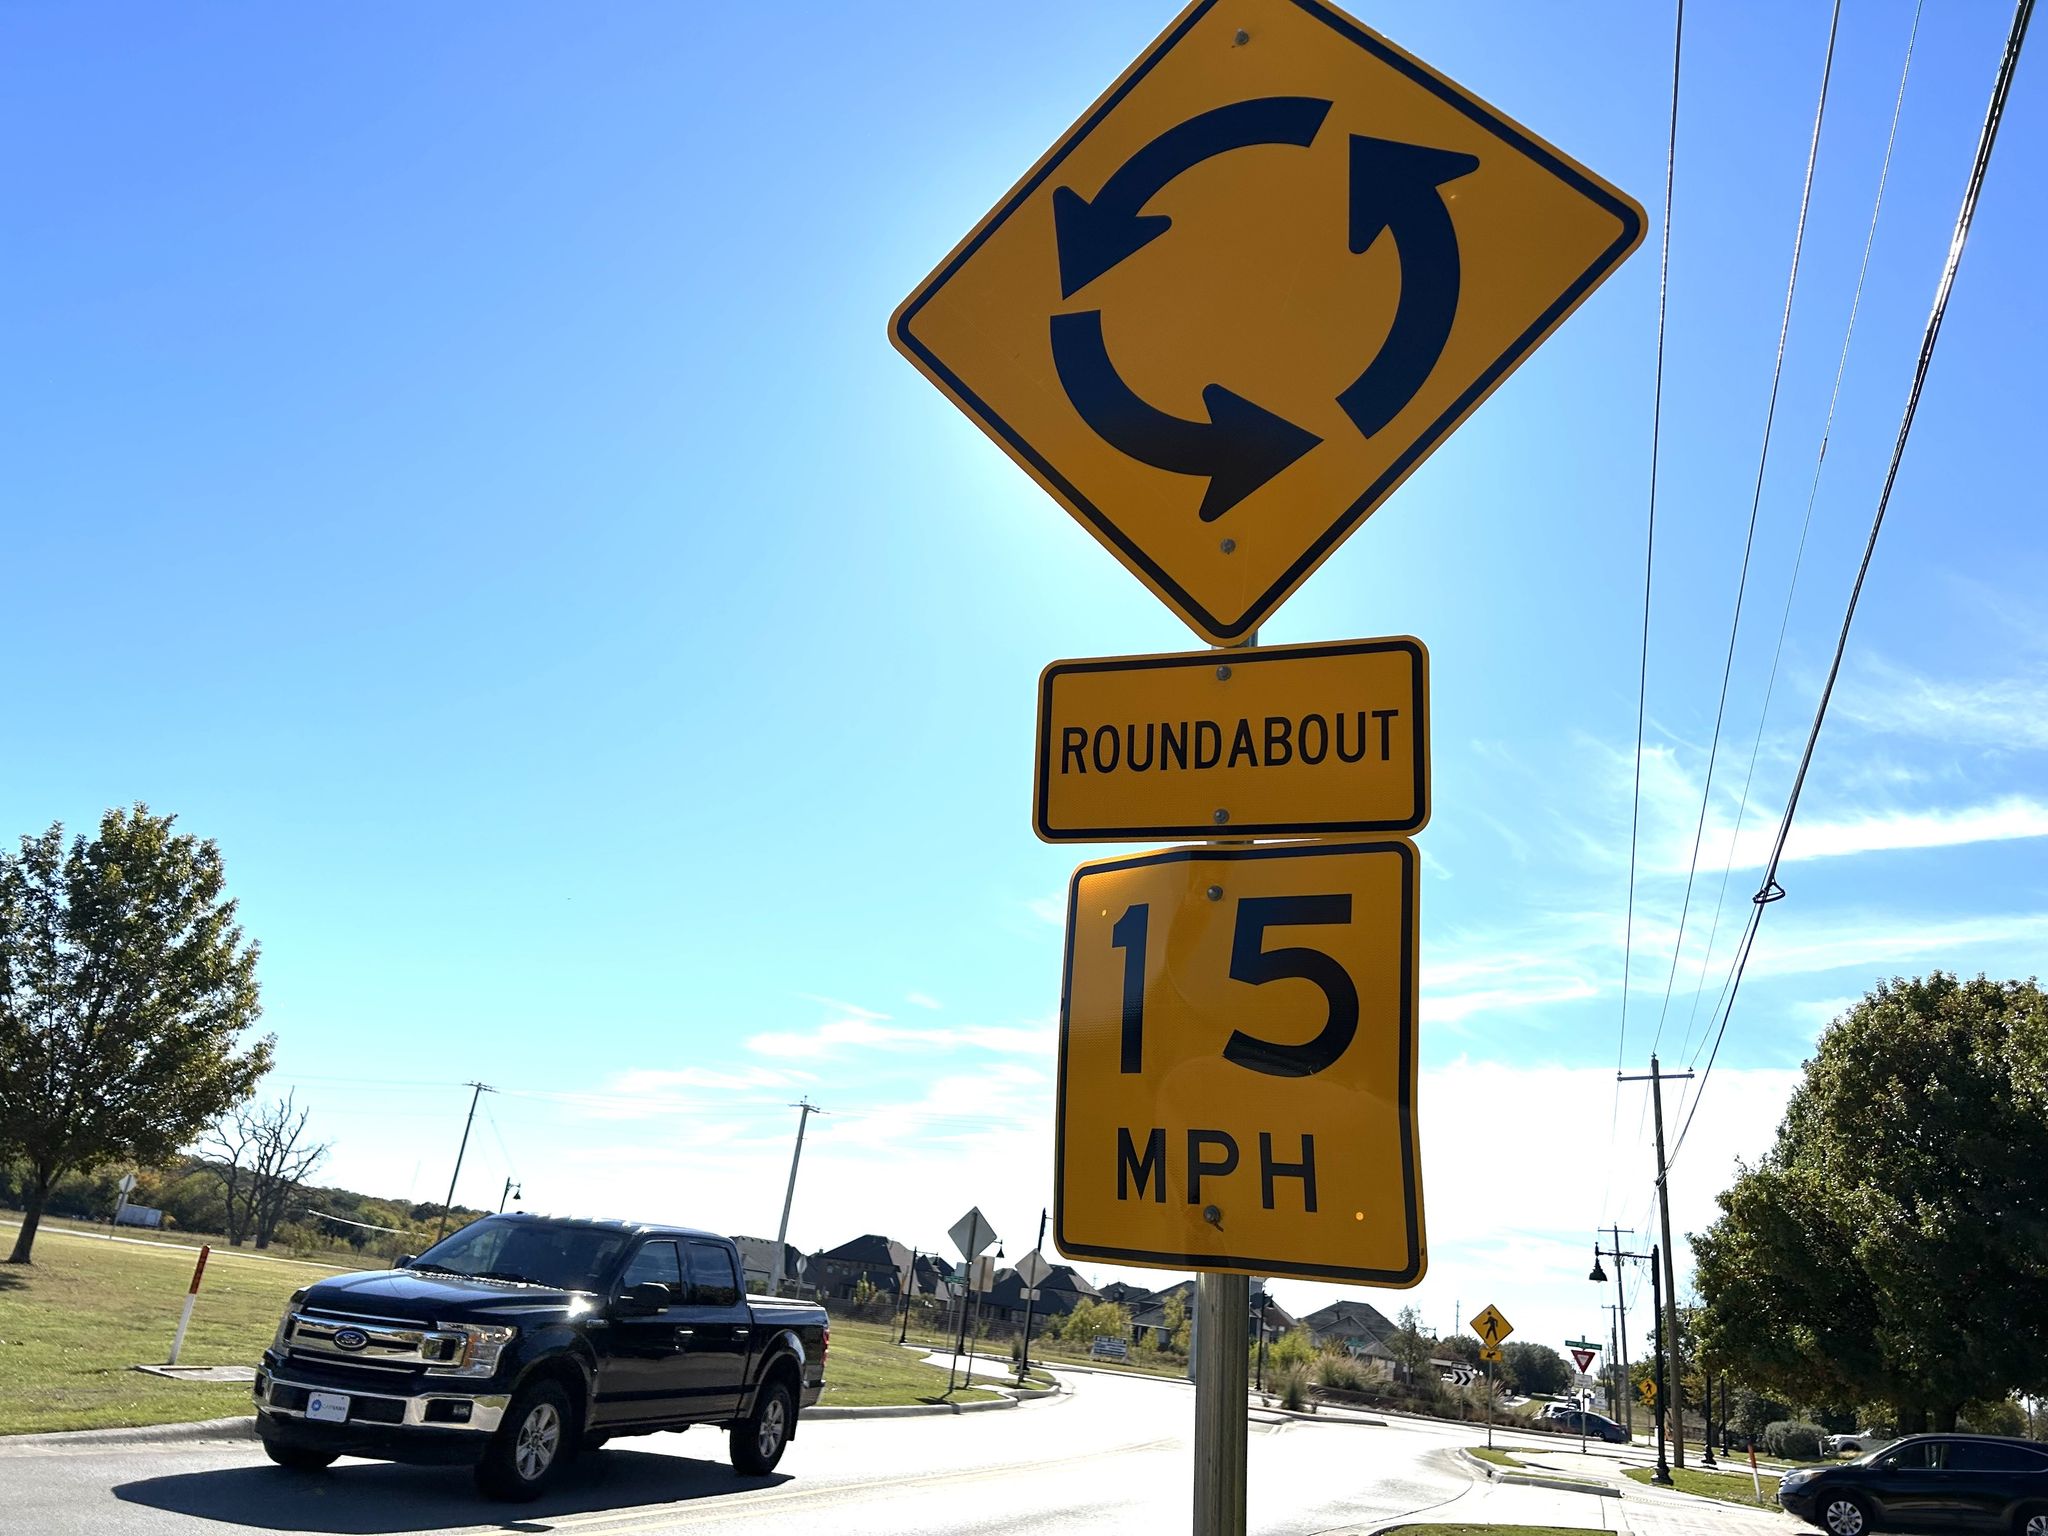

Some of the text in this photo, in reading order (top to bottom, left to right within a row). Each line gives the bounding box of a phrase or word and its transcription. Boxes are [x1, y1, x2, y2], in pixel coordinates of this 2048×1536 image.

[1061, 709, 1399, 775] ROUNDABOUT
[1111, 893, 1360, 1078] 15
[1117, 1127, 1318, 1213] MPH
